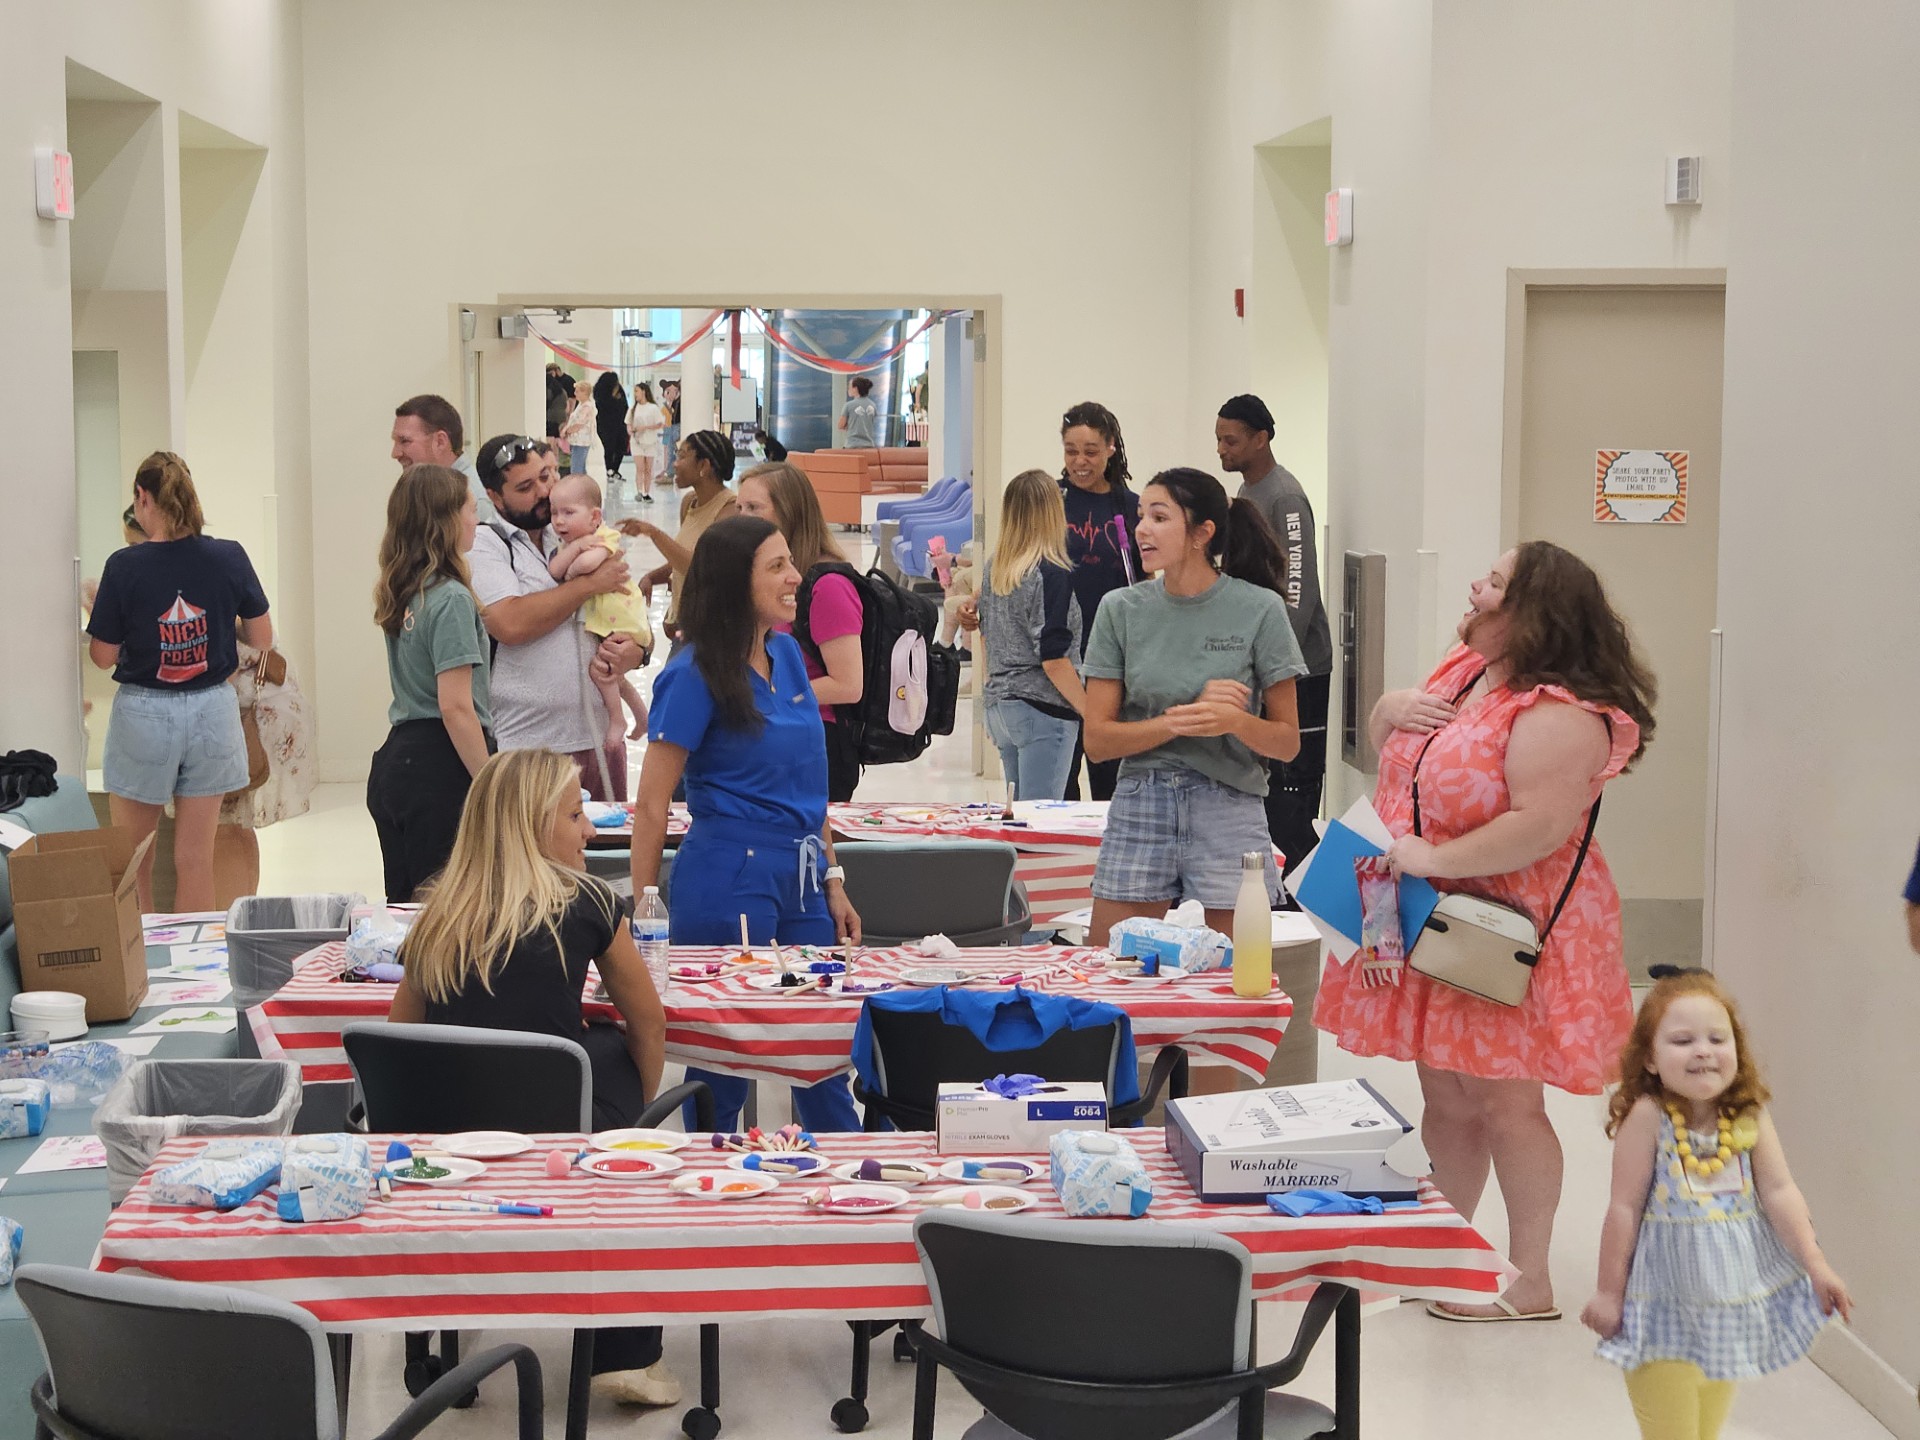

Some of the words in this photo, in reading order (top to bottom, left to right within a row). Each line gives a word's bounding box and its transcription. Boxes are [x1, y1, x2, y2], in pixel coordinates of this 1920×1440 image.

[1612, 467, 1631, 475] SHARE
[1634, 467, 1650, 475] YOUR
[1652, 467, 1671, 476] PARTY
[1614, 475, 1638, 483] PHOTOS
[1285, 511, 1302, 541] NEW
[1288, 544, 1303, 579] YORK
[1286, 581, 1302, 609] CITY
[159, 616, 208, 644] NICU
[160, 634, 209, 651] CARNIVAL
[160, 642, 208, 664] CREW
[1036, 1107, 1044, 1117] L
[1073, 1107, 1101, 1117] 5064
[1229, 1158, 1299, 1172] Washable
[1263, 1174, 1340, 1187] MARKERS
